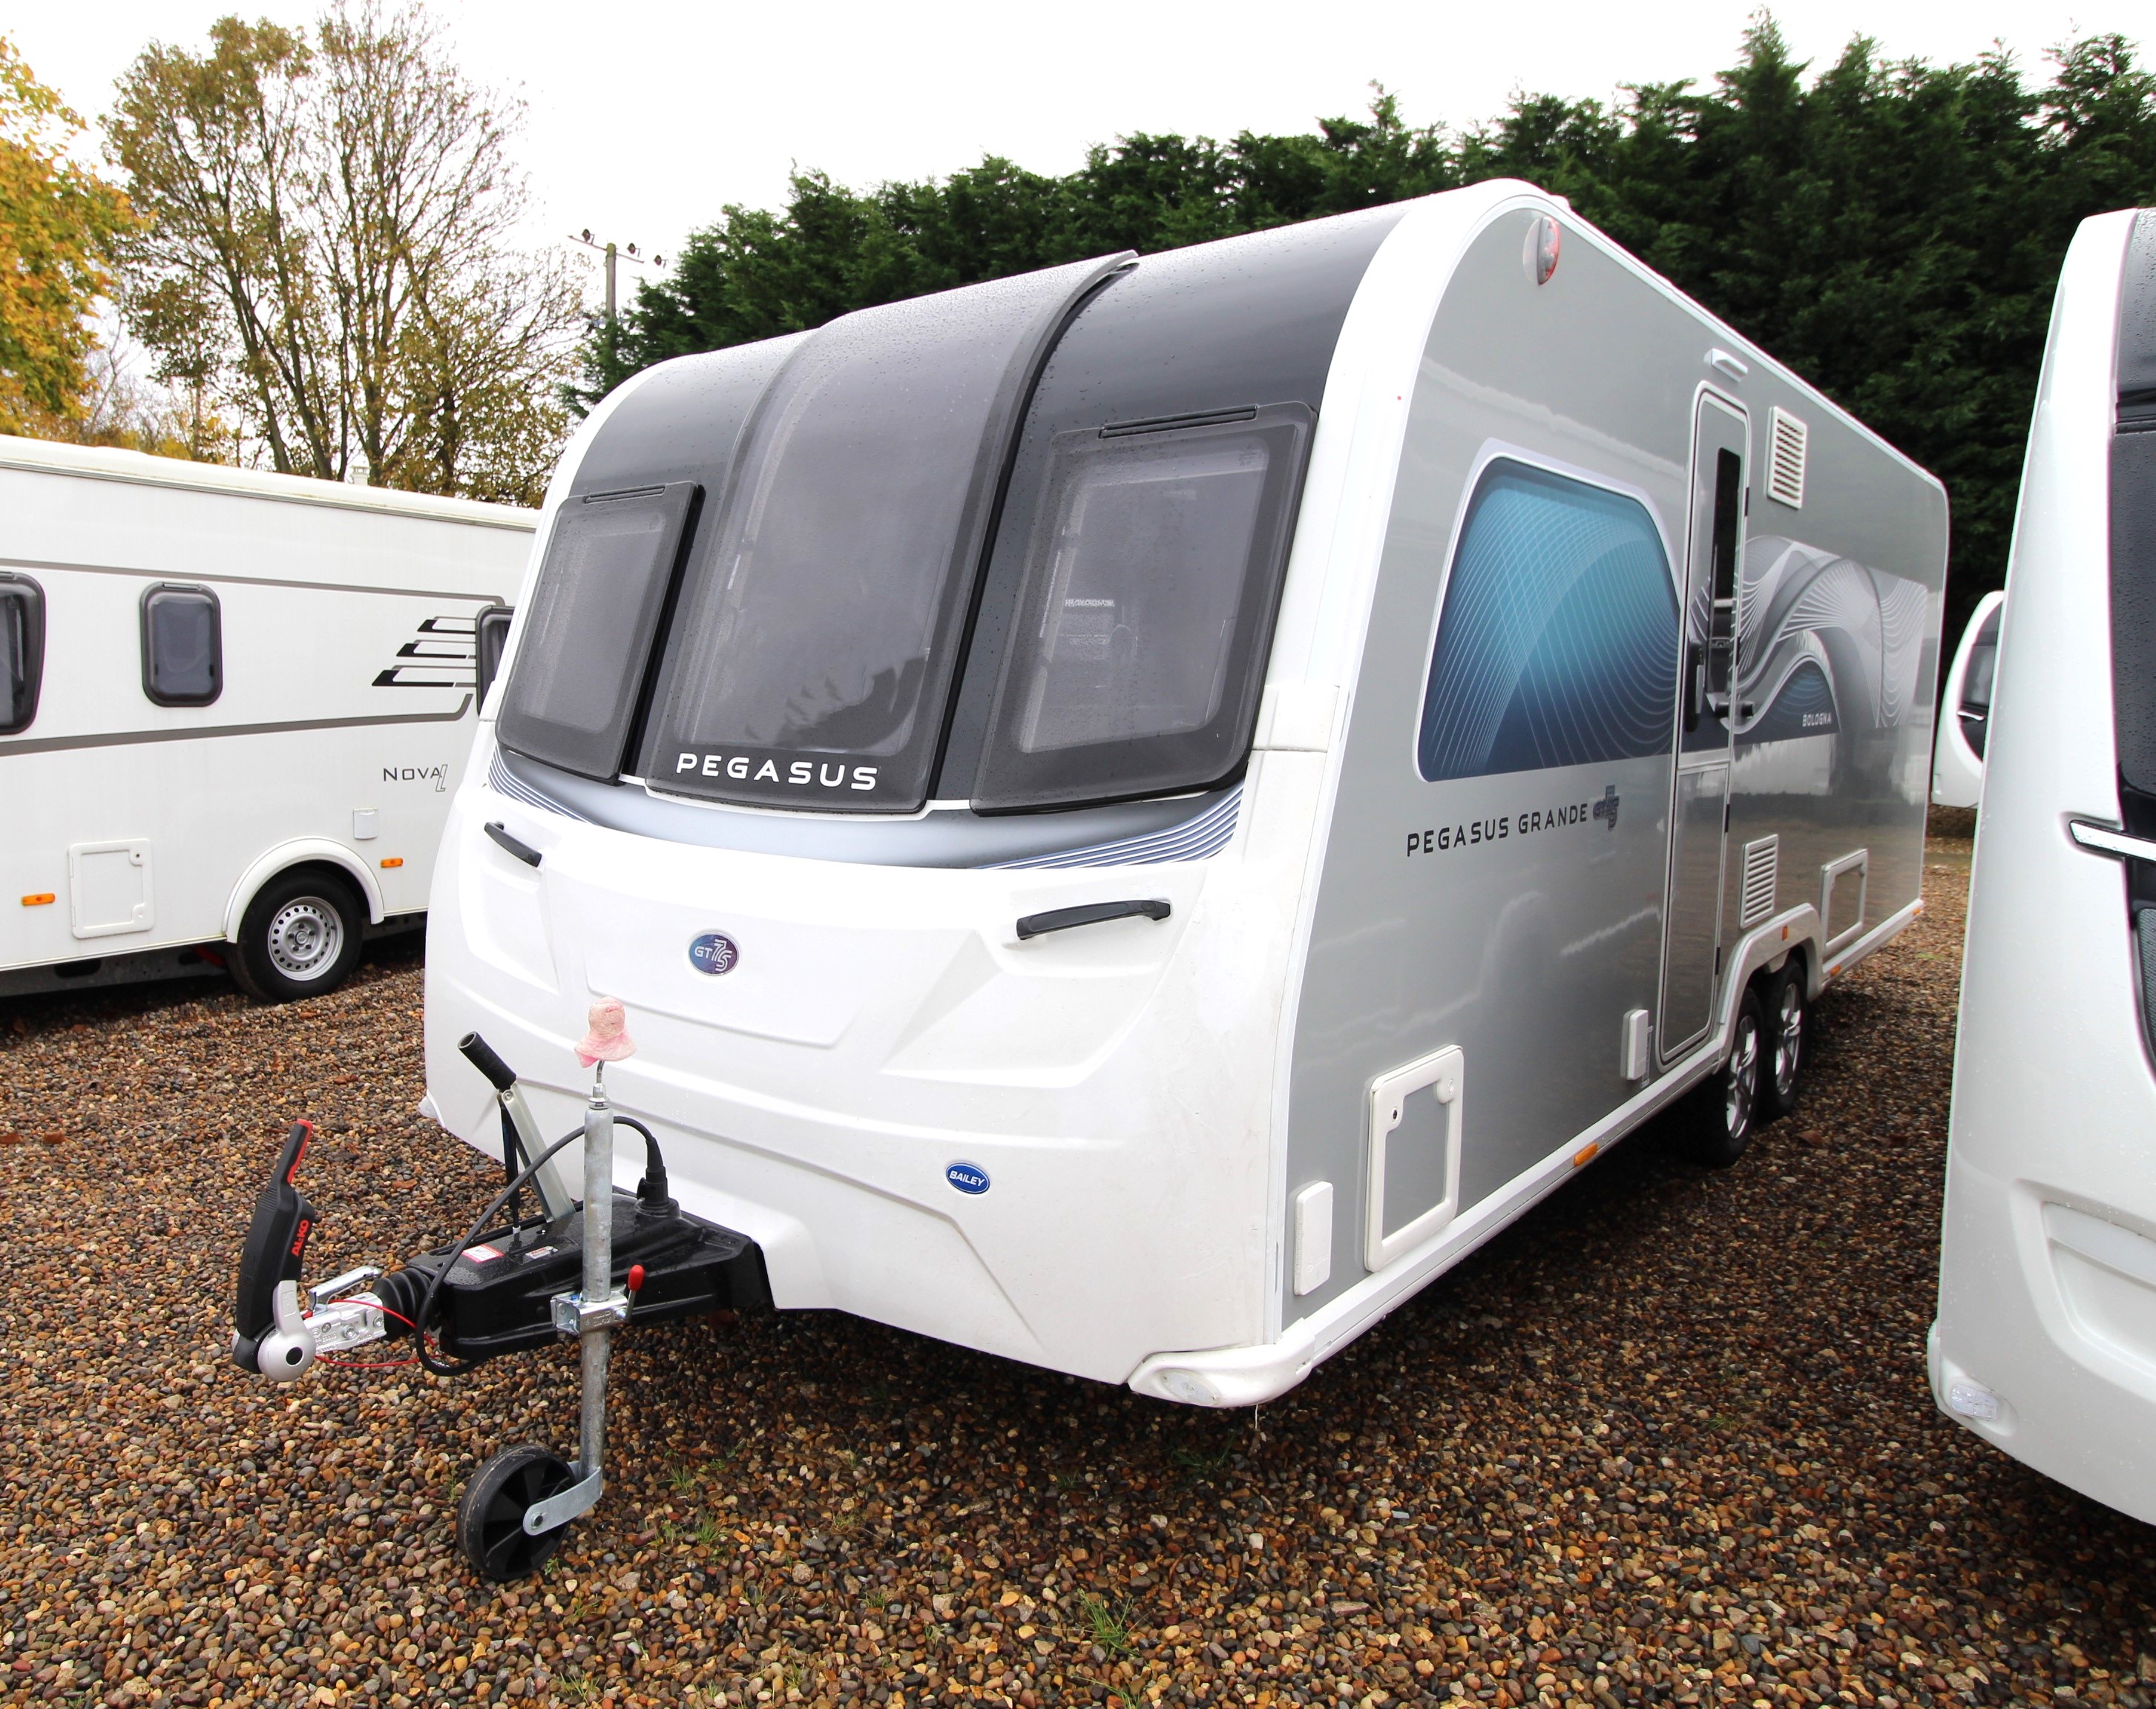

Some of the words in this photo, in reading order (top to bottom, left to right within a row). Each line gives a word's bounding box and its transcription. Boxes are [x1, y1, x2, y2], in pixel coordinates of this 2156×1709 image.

[1802, 713, 1832, 727] BOLOGNA
[676, 752, 878, 791] PEGASUS
[1407, 817, 1508, 857] PEGASUS
[1518, 803, 1588, 834] GRANDE
[950, 1170, 985, 1187] BAILEY
[291, 1219, 309, 1257] AL-KO
